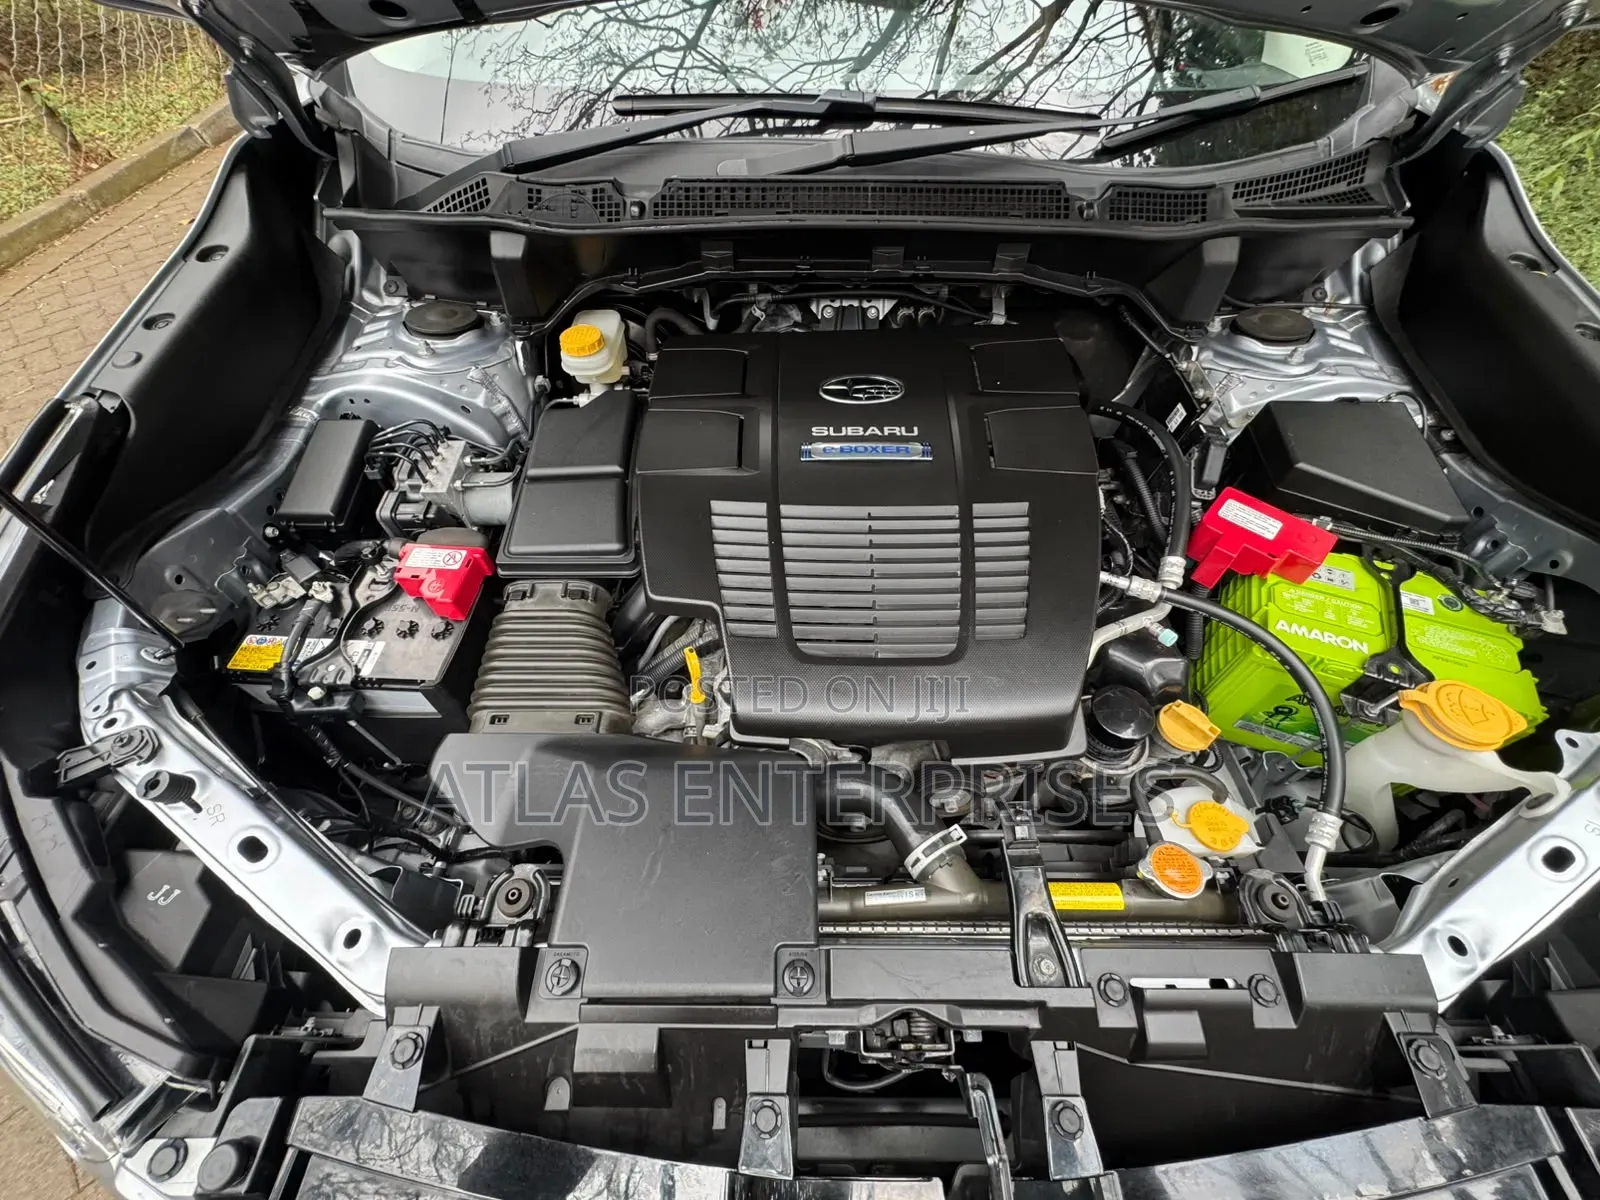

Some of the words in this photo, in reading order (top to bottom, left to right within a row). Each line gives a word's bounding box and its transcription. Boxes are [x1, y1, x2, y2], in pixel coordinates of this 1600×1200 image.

[811, 426, 919, 437] SUBARU
[822, 445, 912, 454] e-BOXER
[1275, 619, 1369, 654] AMARON
[206, 803, 226, 827] SR
